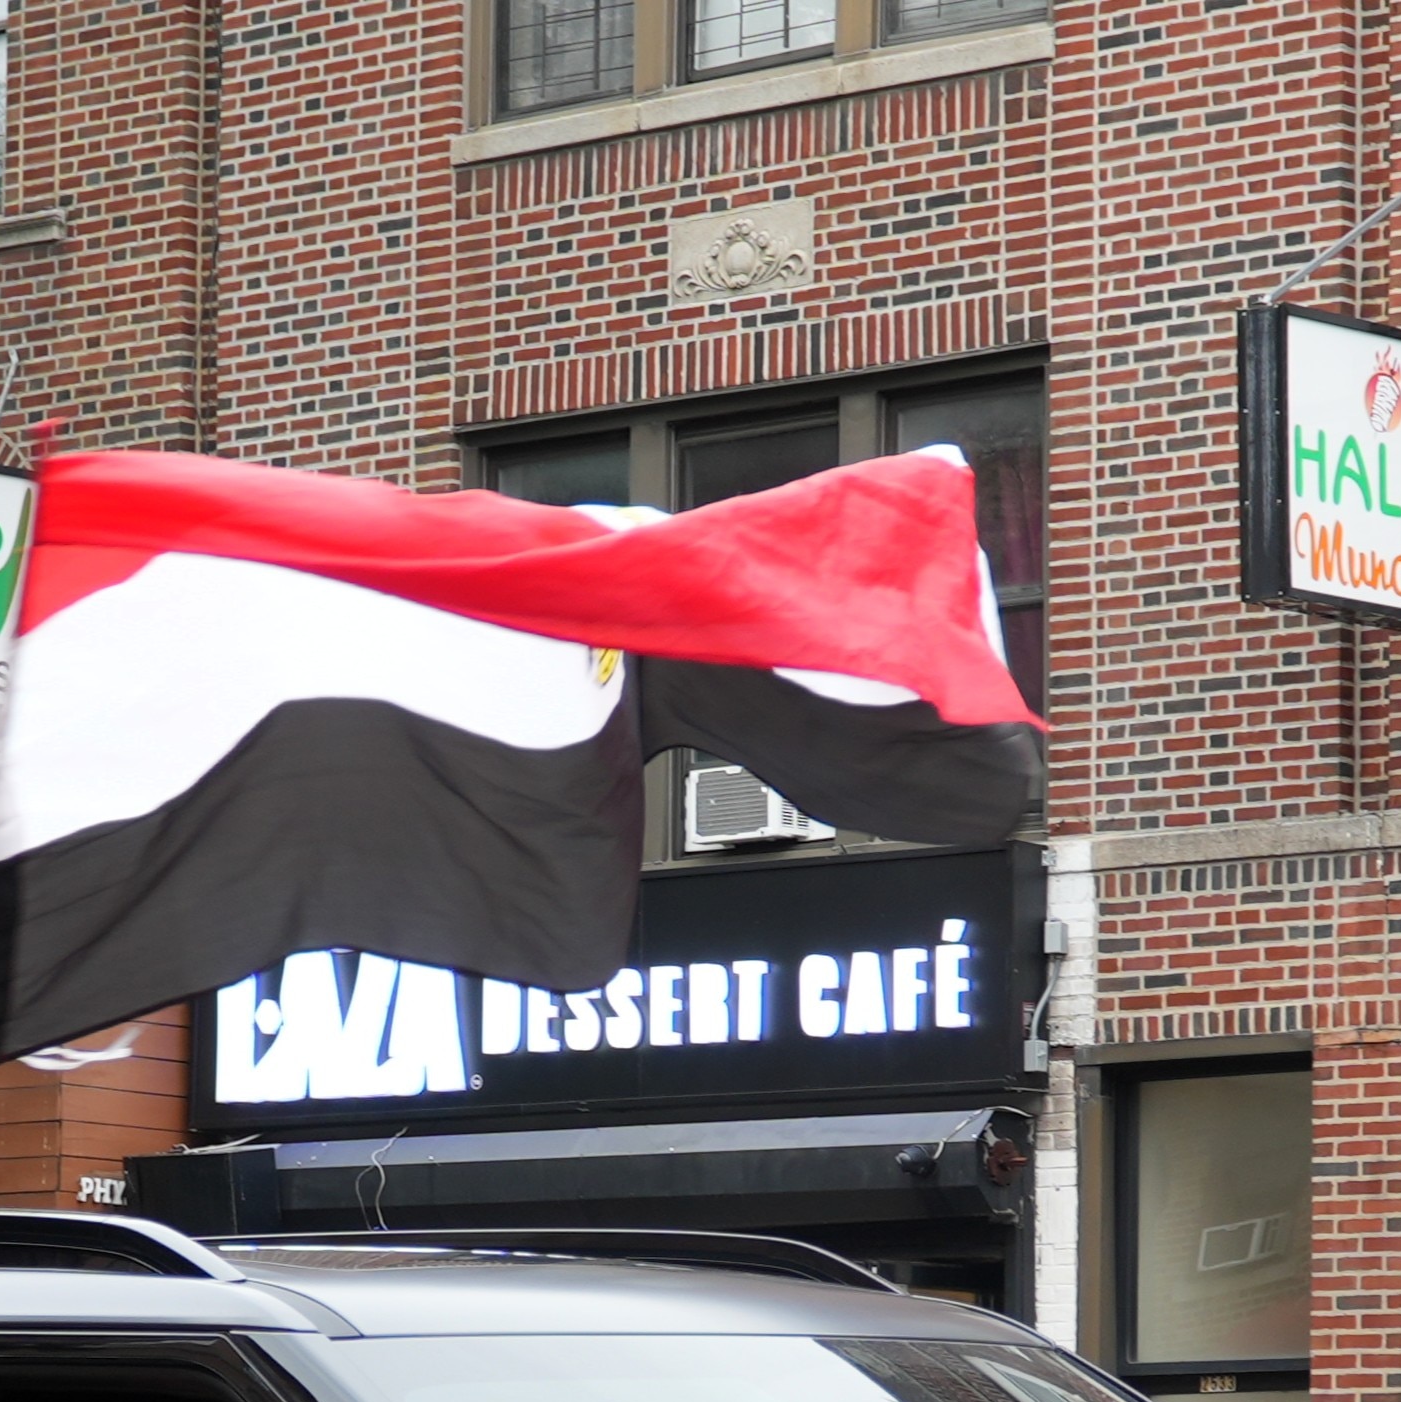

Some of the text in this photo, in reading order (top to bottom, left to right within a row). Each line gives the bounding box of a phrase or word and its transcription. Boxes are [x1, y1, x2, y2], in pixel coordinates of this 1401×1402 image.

[481, 958, 770, 1057] DESSERT
[796, 917, 973, 1038] CAFÉ
[77, 1177, 127, 1206] PHY
